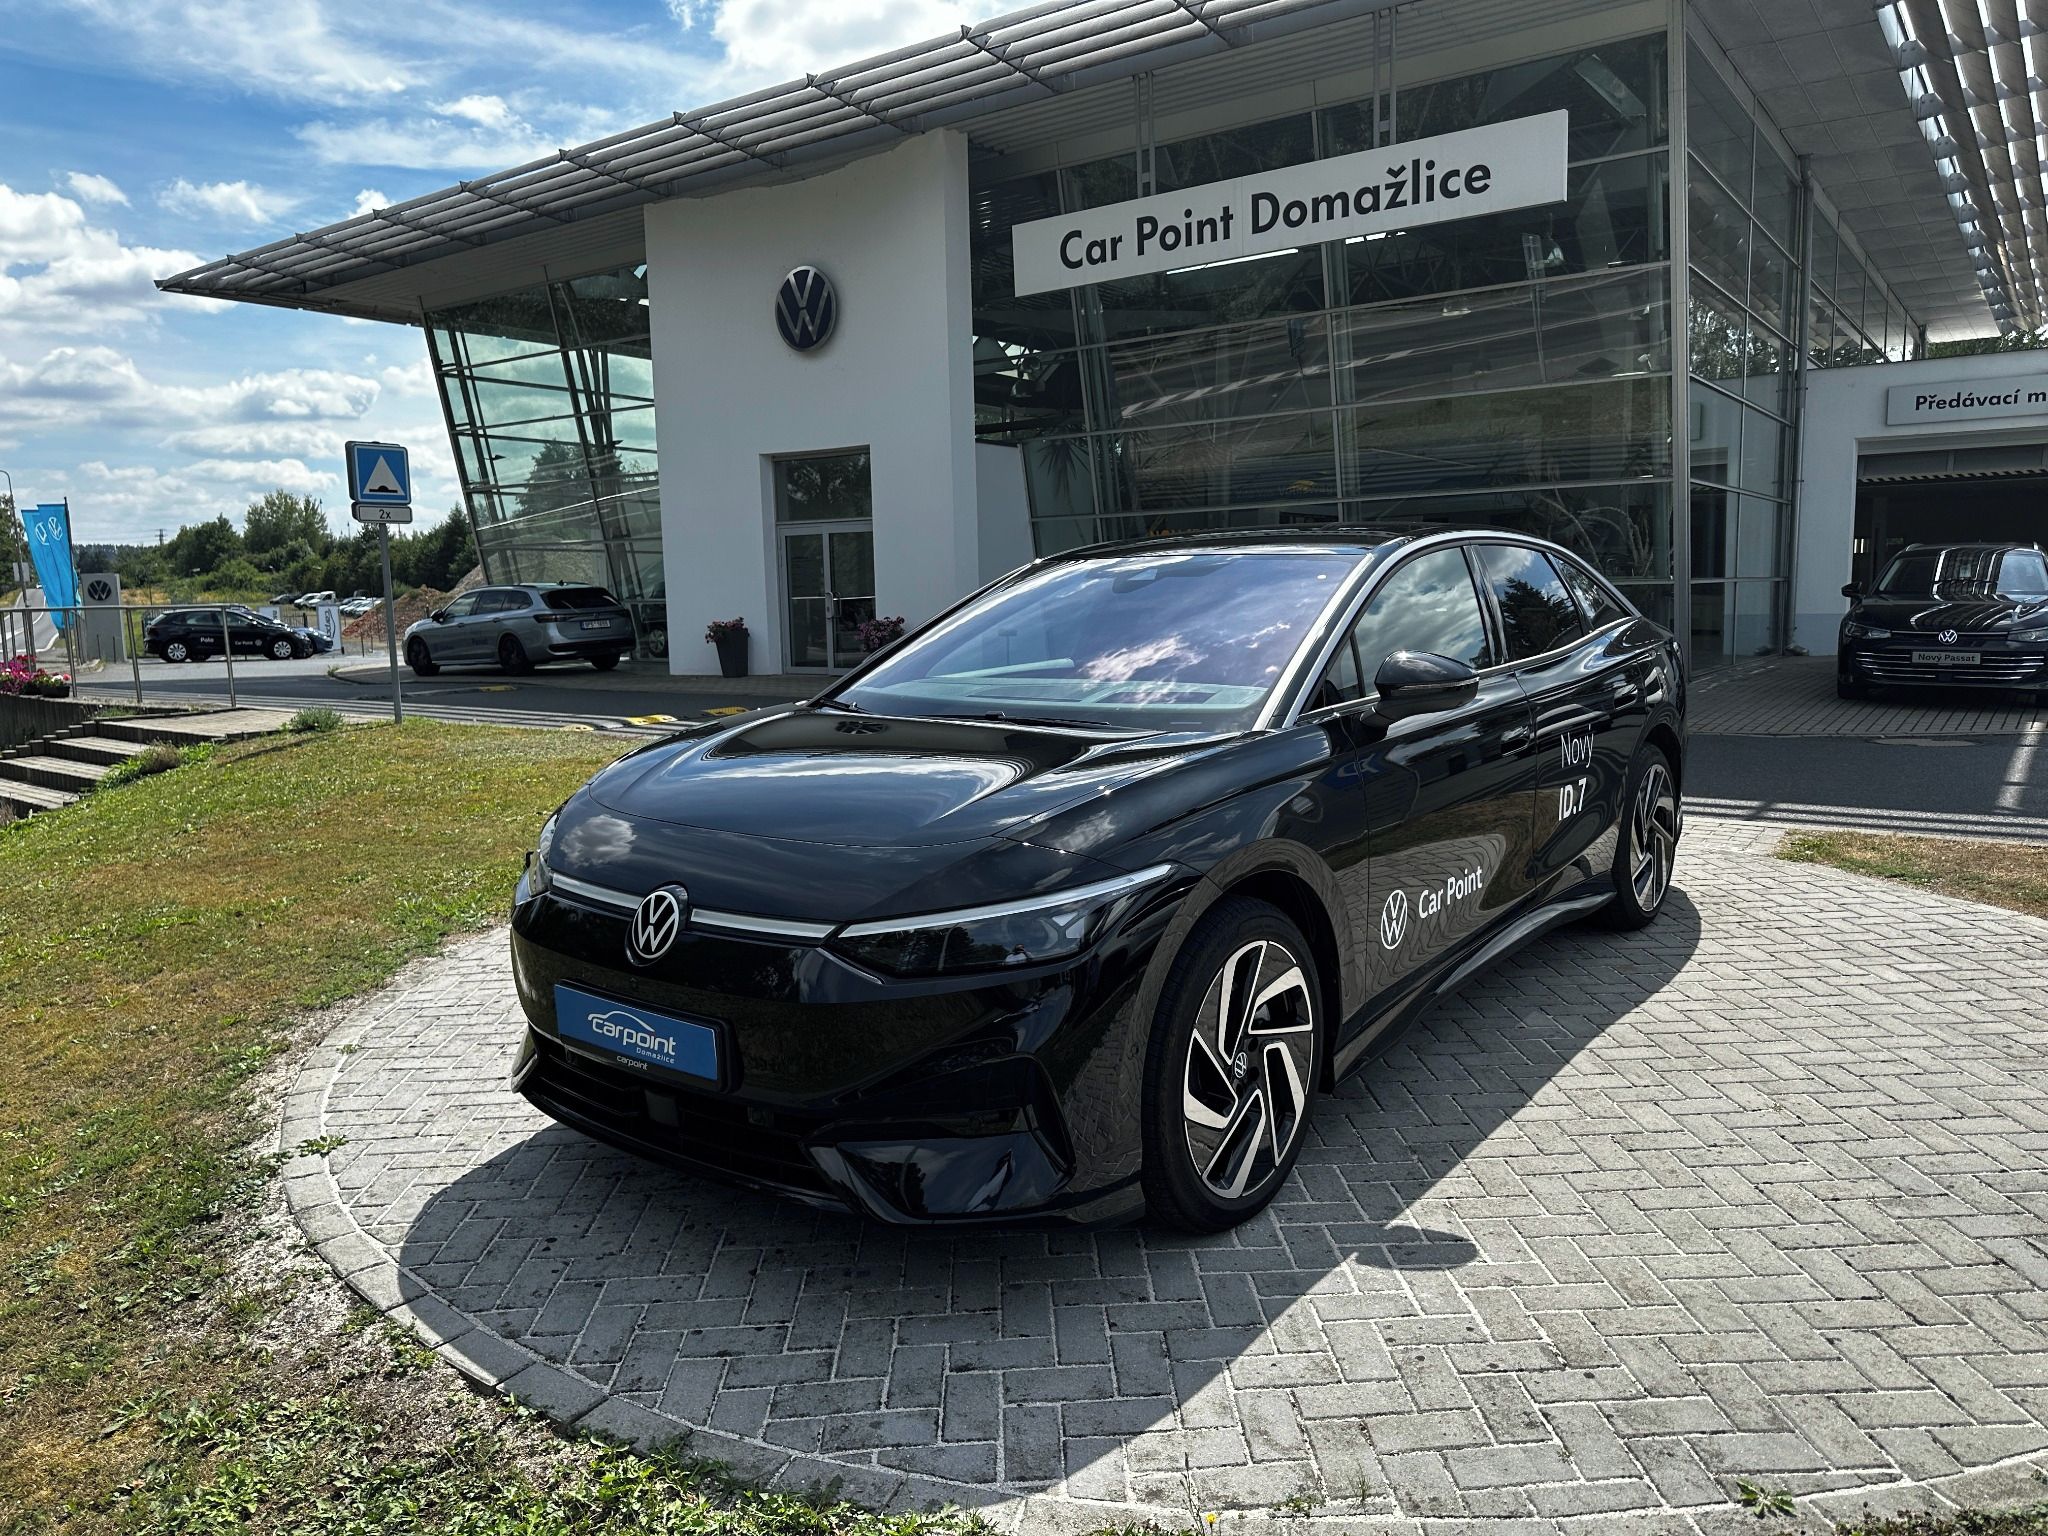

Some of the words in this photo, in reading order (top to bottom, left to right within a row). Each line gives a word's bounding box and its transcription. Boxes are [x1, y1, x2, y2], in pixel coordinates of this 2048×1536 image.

[1059, 229, 1123, 270] Car
[1137, 205, 1235, 256] Point
[1250, 158, 1492, 234] Domažlice
[1915, 388, 2021, 411] Předávací
[379, 509, 392, 519] 2x
[1918, 653, 1942, 662] Nový
[1945, 654, 1976, 662] Passat
[1561, 723, 1594, 769] Nový
[1559, 777, 1587, 821] ID.7
[1418, 890, 1444, 919] Car
[1446, 866, 1483, 905] Point
[592, 1018, 677, 1056] carpoint
[616, 1055, 648, 1071] carpoint
